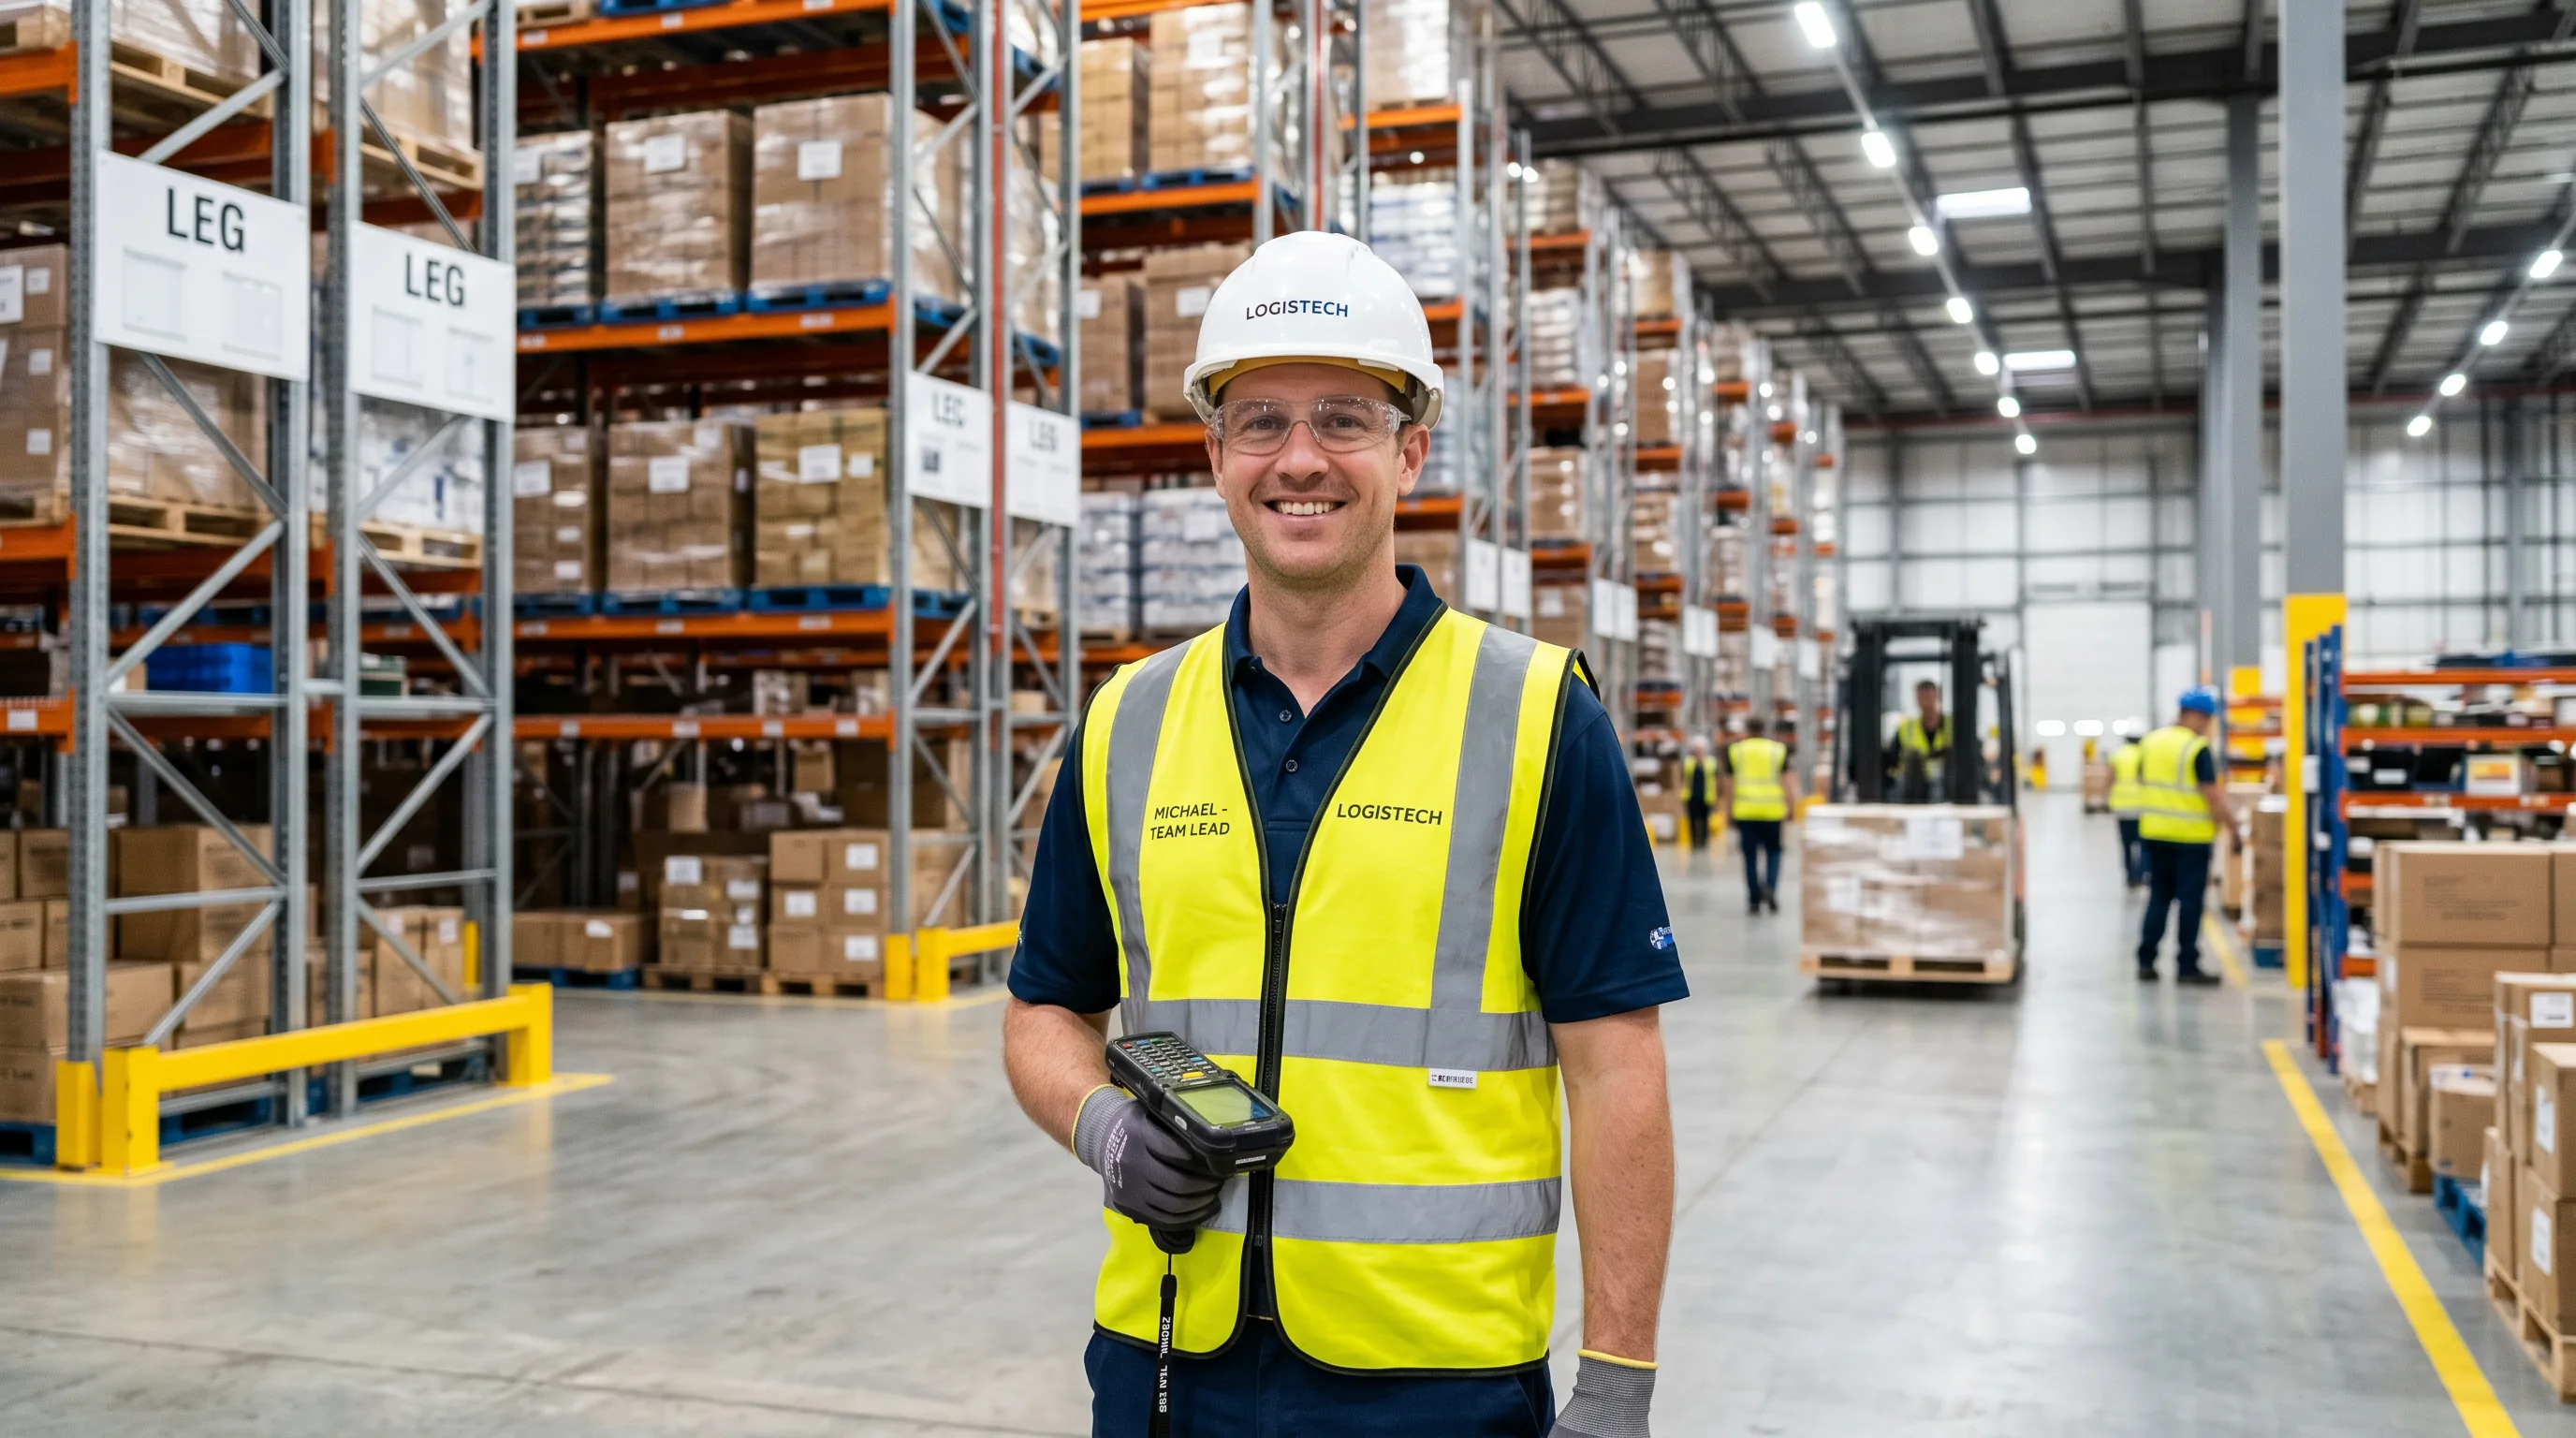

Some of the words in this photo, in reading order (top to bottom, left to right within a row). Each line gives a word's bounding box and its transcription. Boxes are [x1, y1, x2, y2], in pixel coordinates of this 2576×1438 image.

[167, 187, 245, 254] LEG
[404, 252, 465, 308] LEG
[1246, 300, 1348, 320] LOGISTECH
[1154, 802, 1218, 820] MICHAEL
[1337, 803, 1442, 825] LOGISTECH
[1149, 824, 1186, 841] TEAM
[1190, 822, 1230, 836] LEAD
